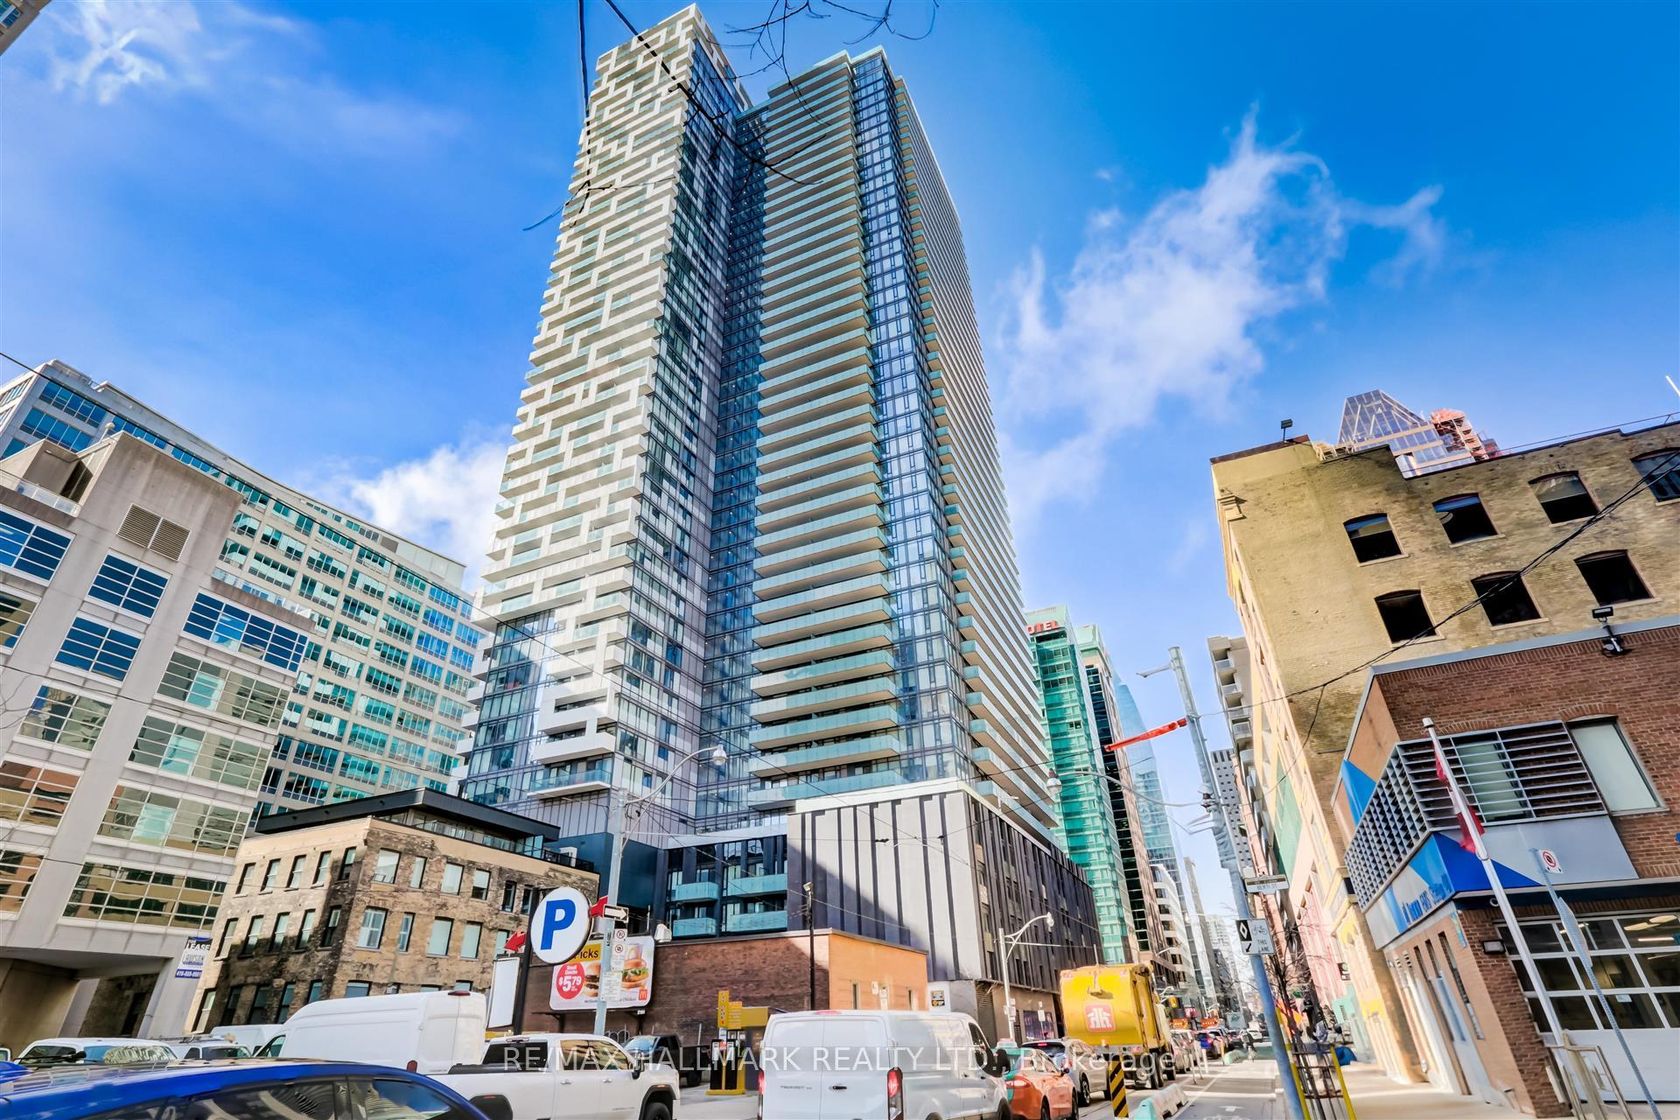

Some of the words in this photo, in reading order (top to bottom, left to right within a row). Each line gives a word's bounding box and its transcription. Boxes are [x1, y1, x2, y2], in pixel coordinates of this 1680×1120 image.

[1025, 621, 1059, 634] OTEL
[541, 899, 576, 950] P
[186, 942, 210, 951] LEASE
[574, 949, 599, 959] icks
